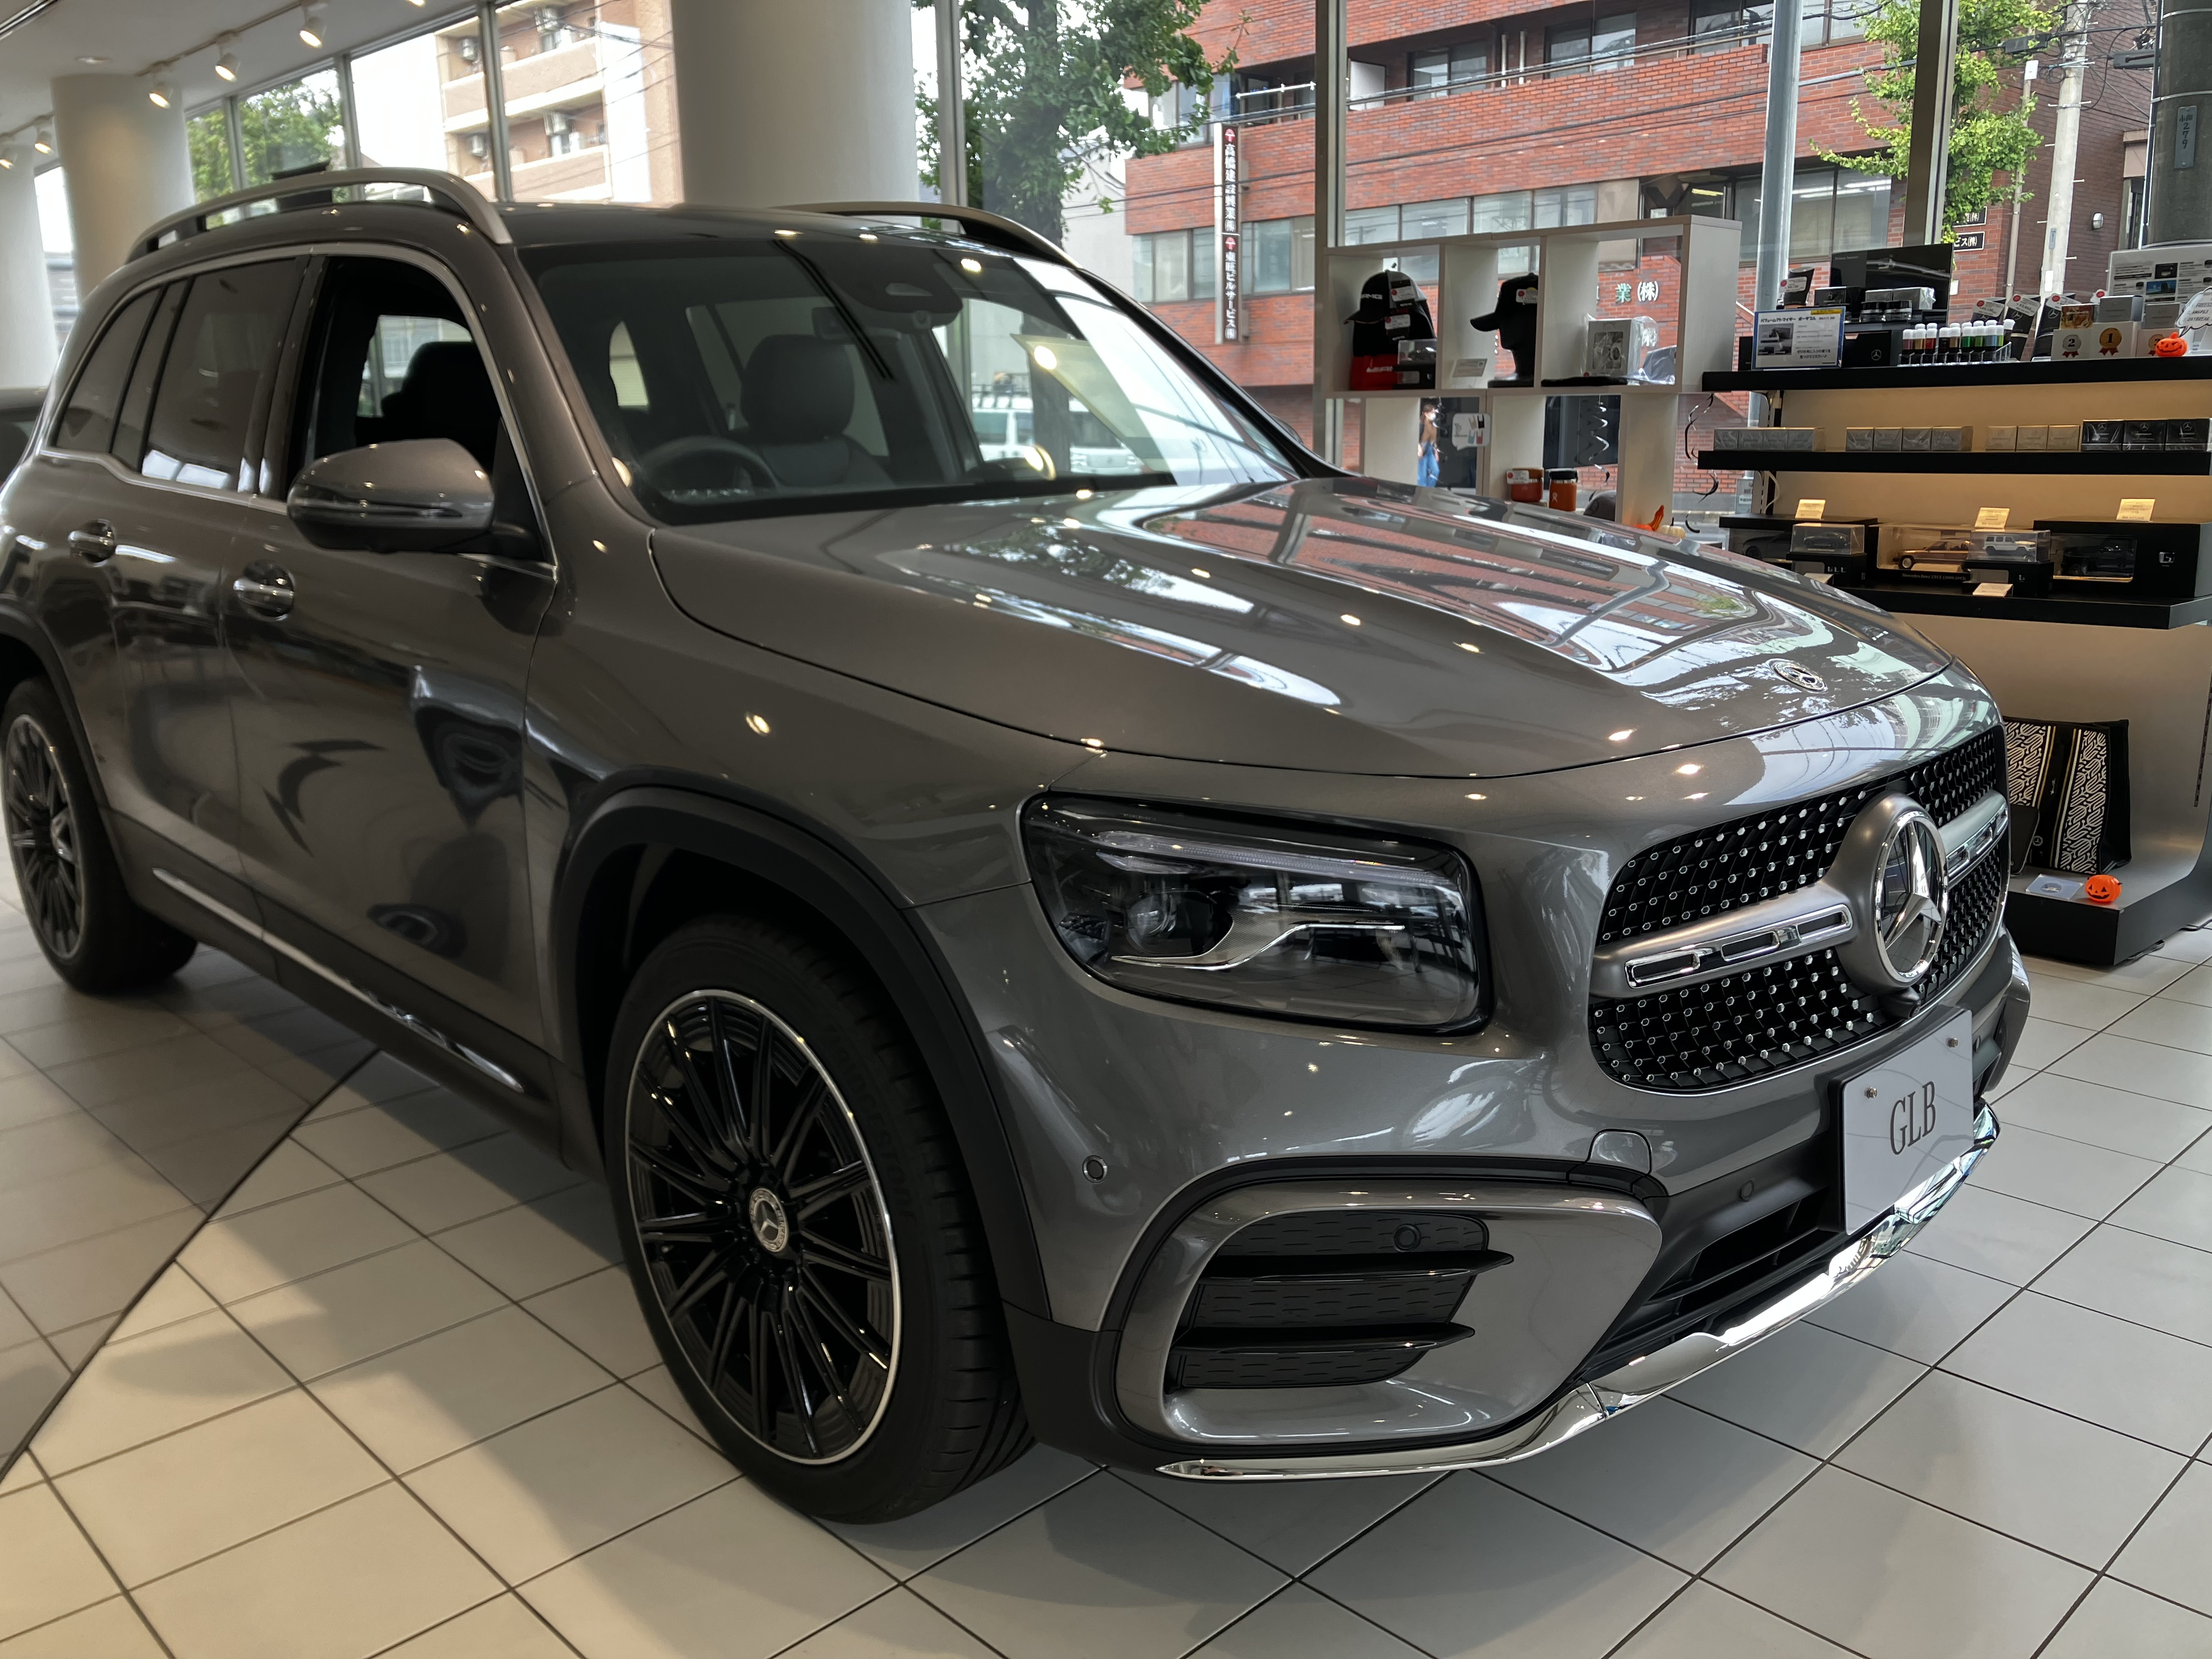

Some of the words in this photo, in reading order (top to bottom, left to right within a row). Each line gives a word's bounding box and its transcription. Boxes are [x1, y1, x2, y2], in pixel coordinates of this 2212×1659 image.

[2182, 122, 2190, 149] 279
[2067, 338, 2076, 347] 2
[2106, 333, 2113, 343] 1
[1889, 1080, 1937, 1155] GLB
